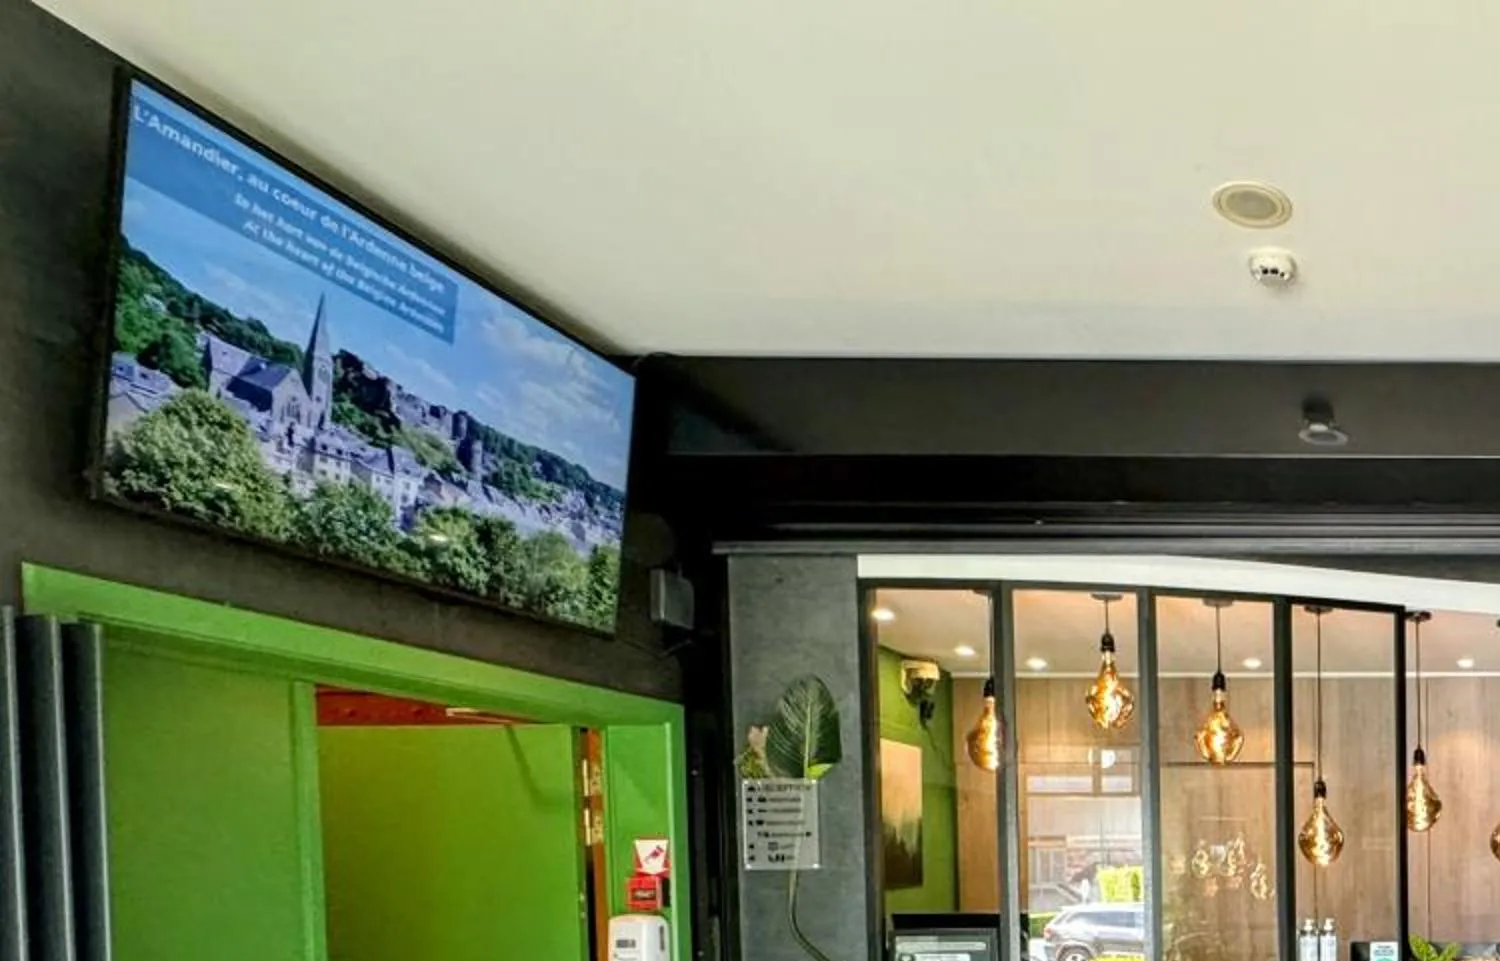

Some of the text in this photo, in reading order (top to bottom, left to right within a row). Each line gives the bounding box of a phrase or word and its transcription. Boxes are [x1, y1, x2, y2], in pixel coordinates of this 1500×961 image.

[133, 104, 244, 182] L'Amandier,
[246, 173, 269, 193] au
[320, 215, 338, 234] de
